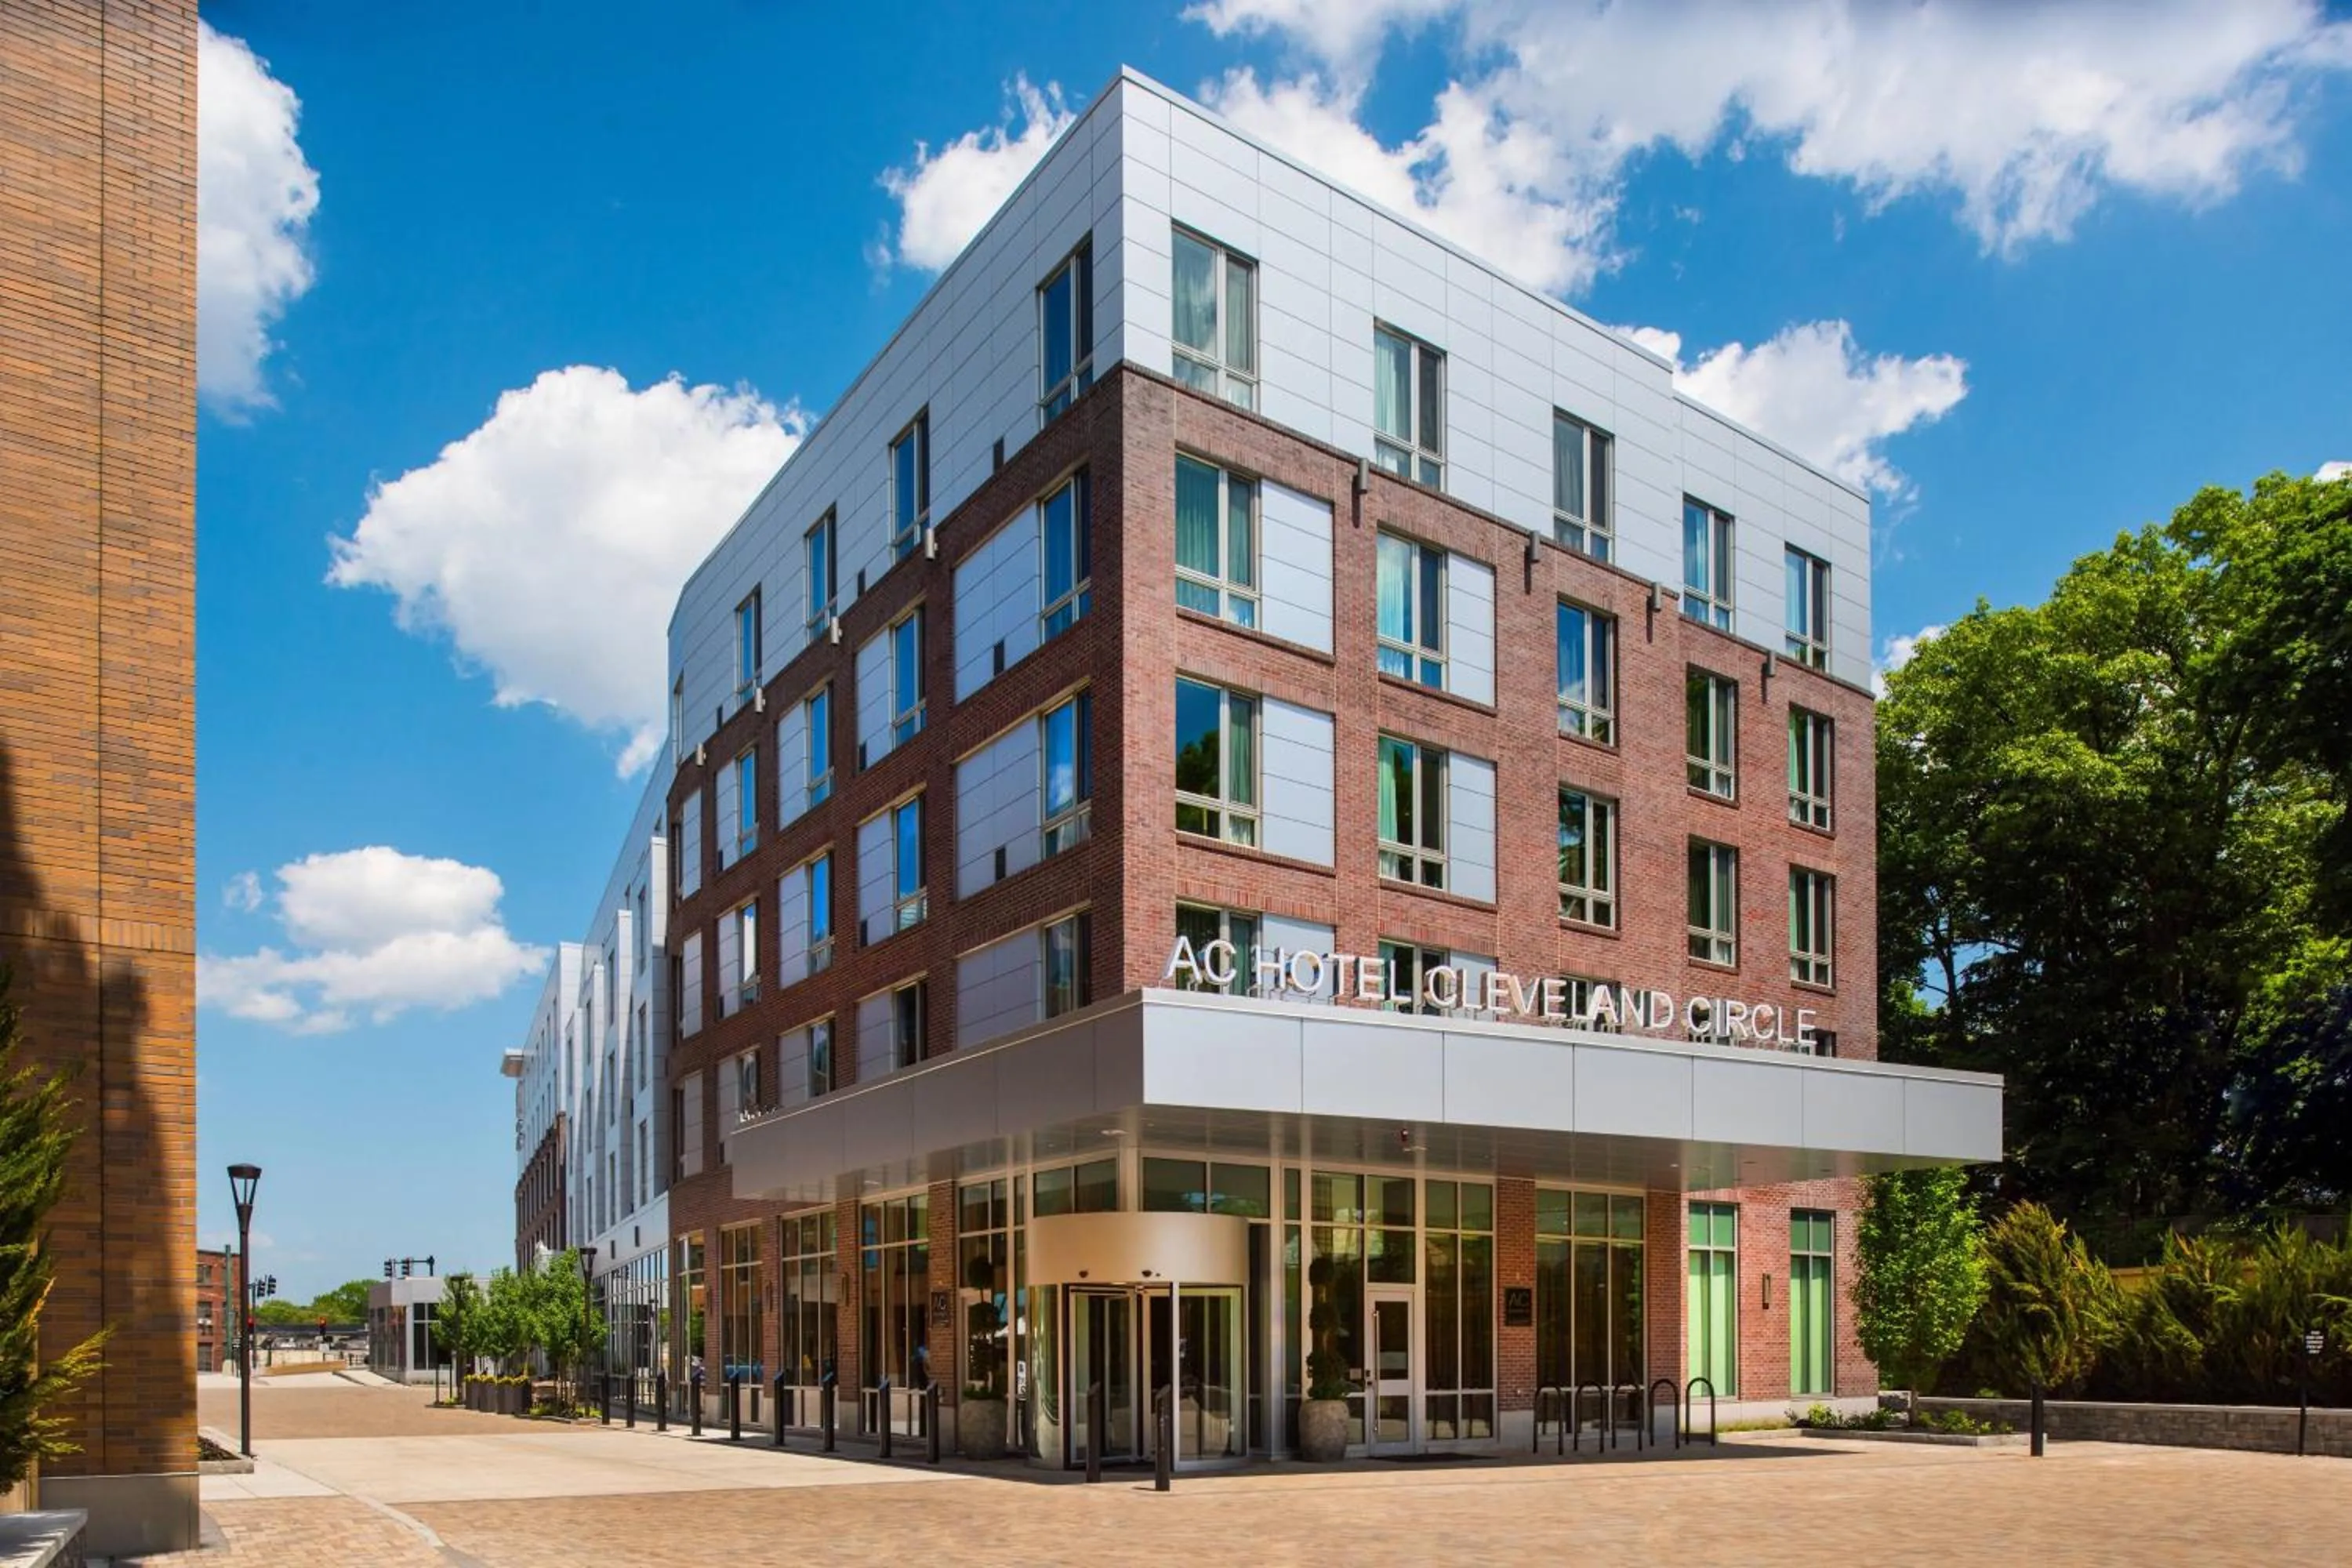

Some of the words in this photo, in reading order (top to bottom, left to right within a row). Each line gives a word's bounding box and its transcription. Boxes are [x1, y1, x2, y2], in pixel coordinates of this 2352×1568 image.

[1163, 935, 1236, 985] AC
[1254, 946, 1412, 1003] HOTEL
[1426, 965, 1674, 1029] CLEVELAND
[1686, 997, 1817, 1045] CIRCLE
[1508, 1292, 1530, 1307] AC
